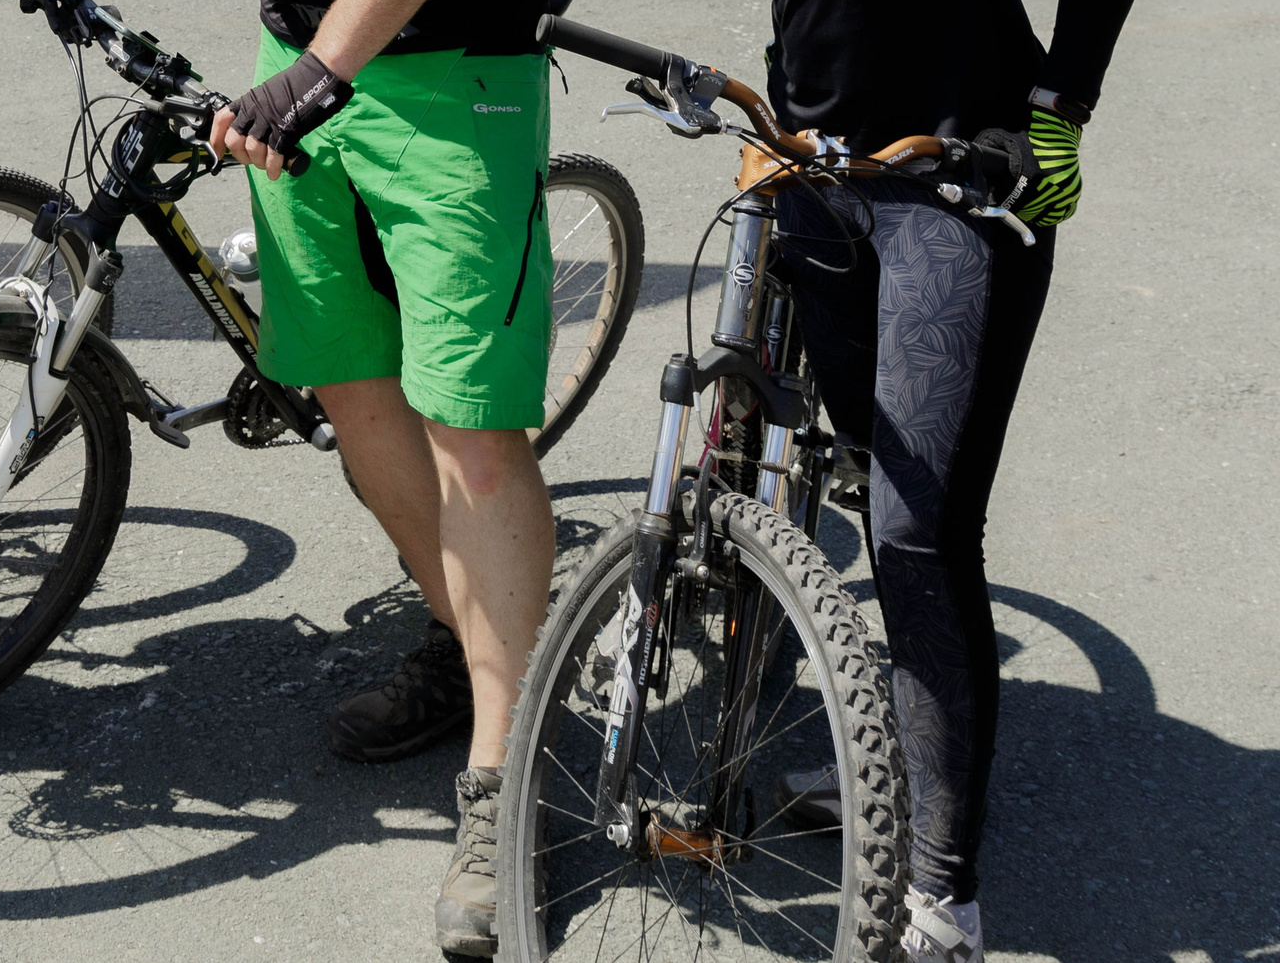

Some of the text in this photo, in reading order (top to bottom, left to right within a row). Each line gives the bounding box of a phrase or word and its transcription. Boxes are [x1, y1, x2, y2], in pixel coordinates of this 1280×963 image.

[302, 74, 330, 103] SPORT
[754, 102, 782, 140] STARK
[188, 272, 244, 339] AVALANCHE
[638, 627, 653, 686] manitou
